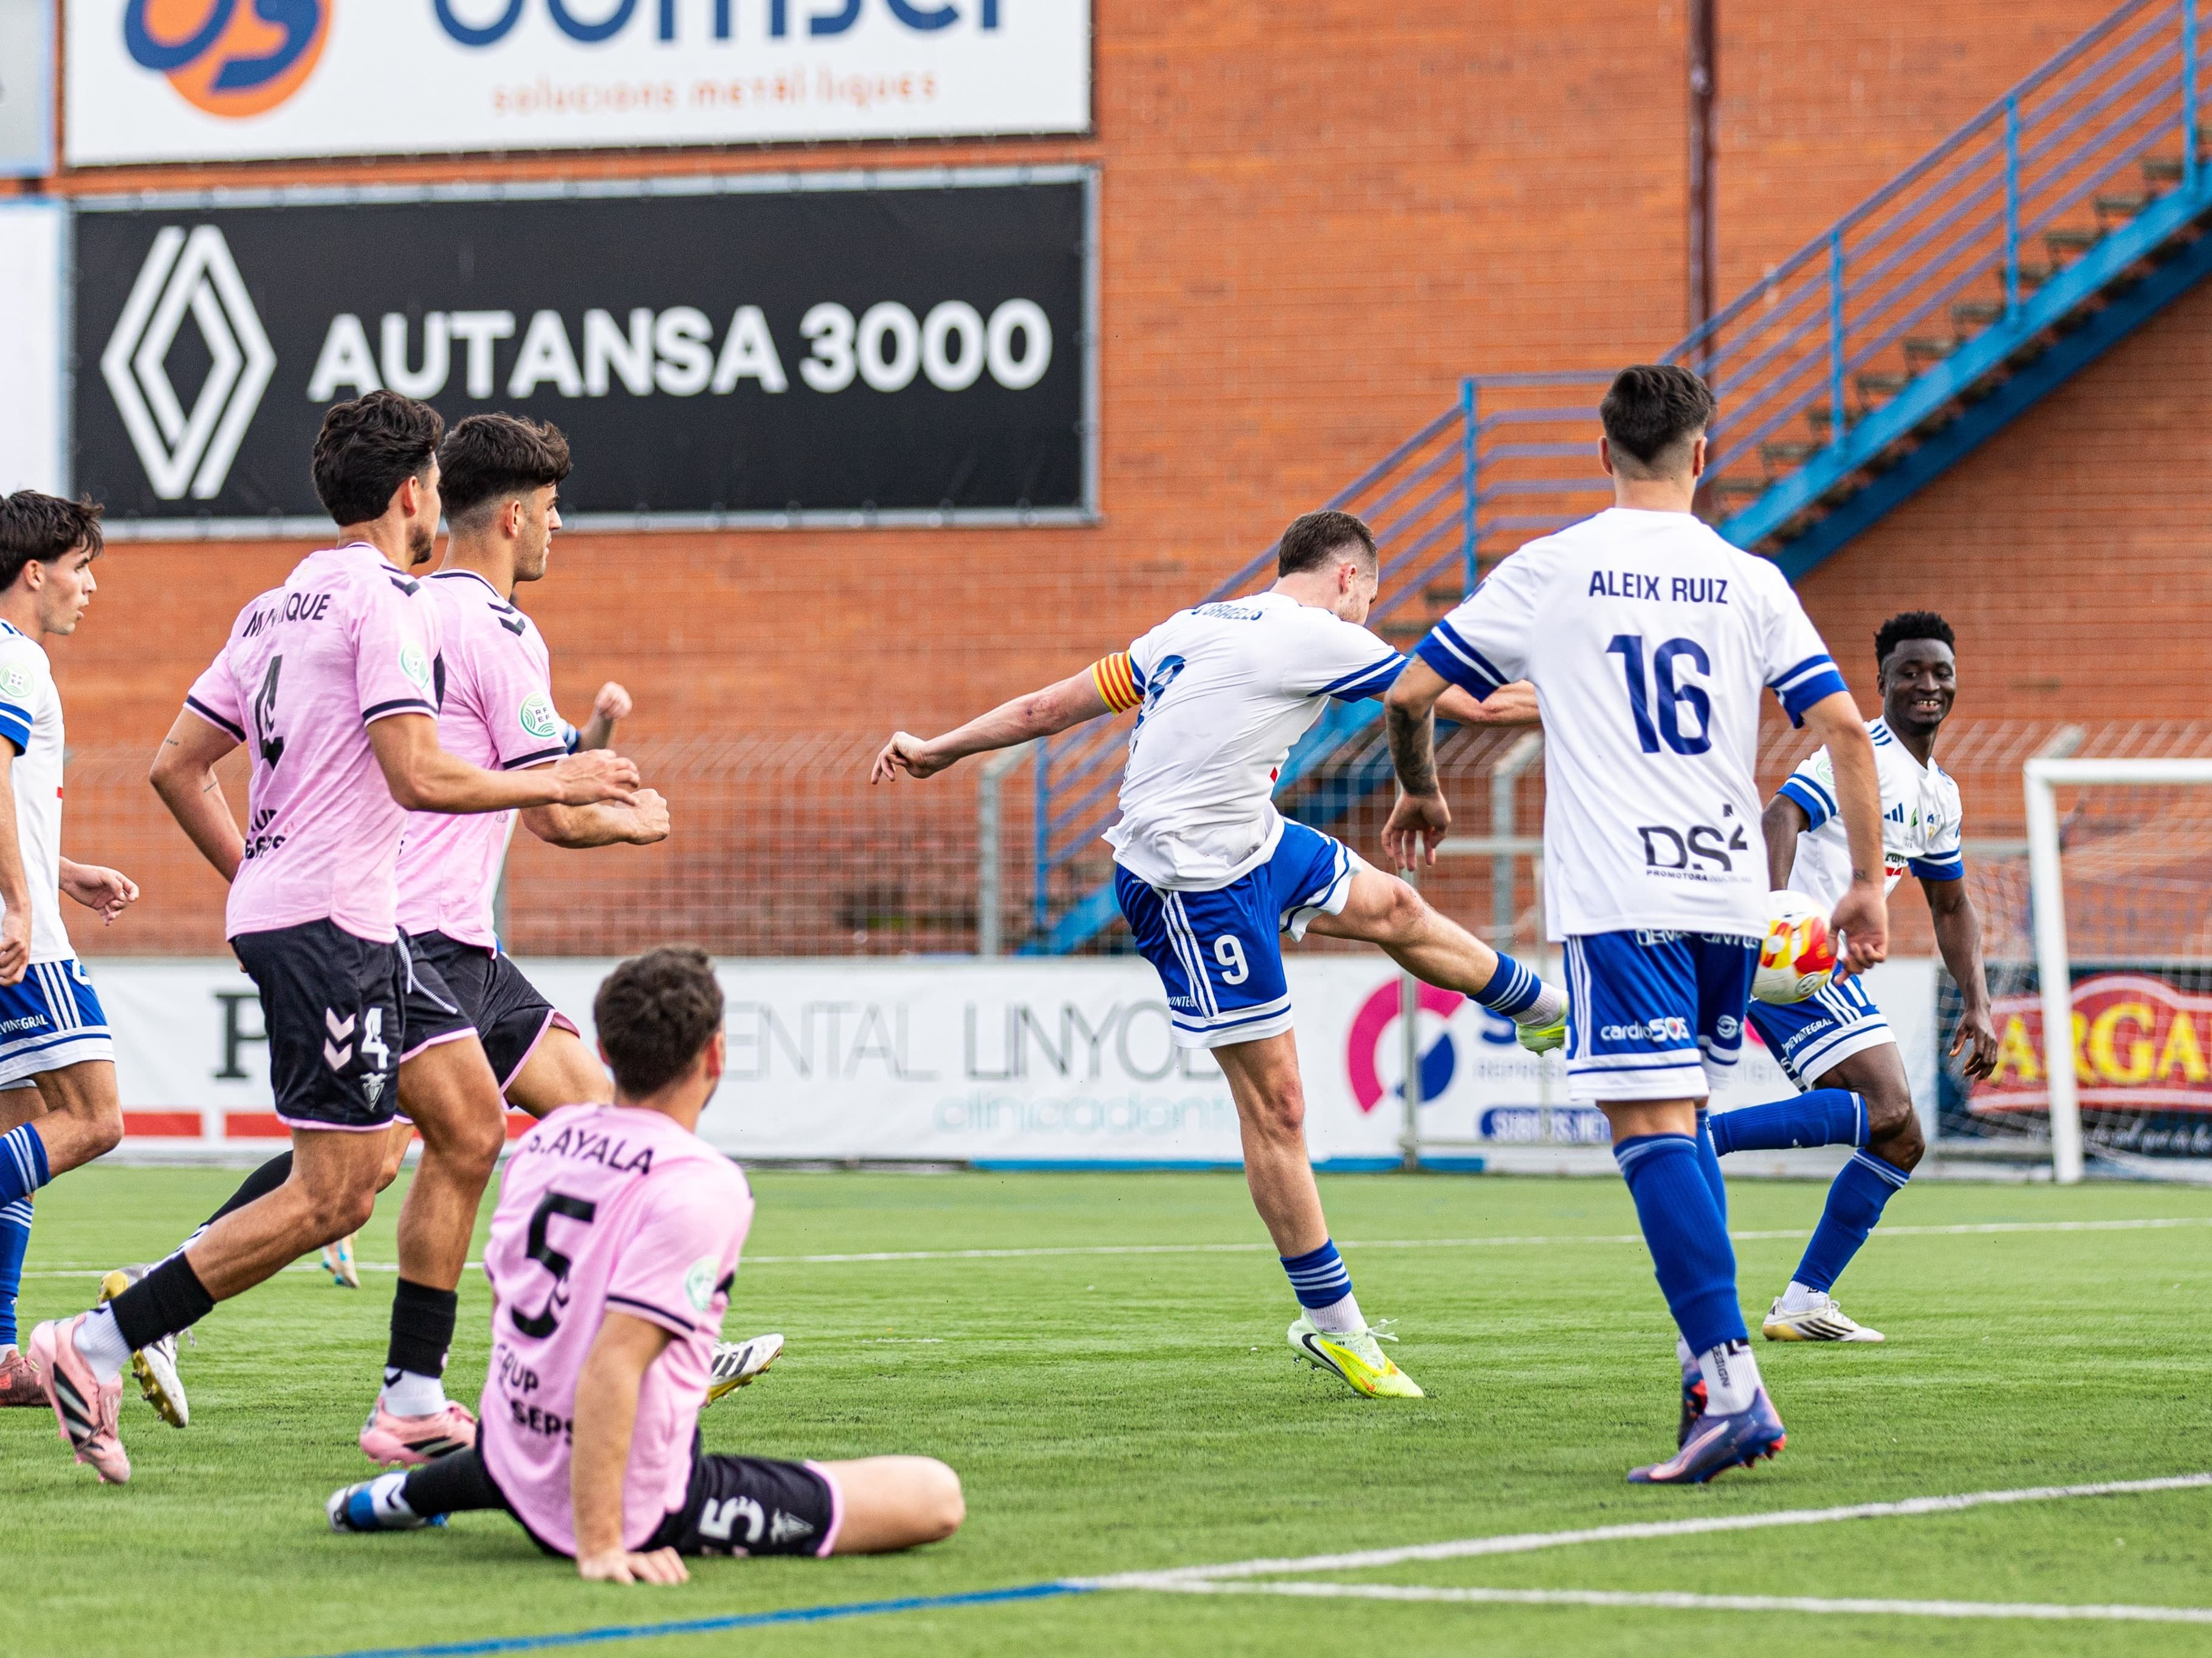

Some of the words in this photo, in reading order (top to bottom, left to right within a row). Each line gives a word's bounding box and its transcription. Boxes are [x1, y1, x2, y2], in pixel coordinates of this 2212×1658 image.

[306, 305, 789, 402] AUTANSA
[799, 299, 1053, 394] 3000
[1589, 570, 1661, 601] ALEIX
[1671, 576, 1728, 604] RUIZ
[254, 654, 284, 770] 4
[1606, 634, 1712, 755] 16
[1646, 869, 1708, 881] PROMOTORA
[1214, 934, 1249, 985] 9
[360, 1007, 390, 1070] 4
[723, 1000, 941, 1082] ENTAL
[964, 999, 1223, 1081] LINYOL
[1991, 1002, 2212, 1085] ARGA
[511, 1189, 596, 1338] 5
[497, 1343, 540, 1394] RUP
[698, 1495, 766, 1544] 5
